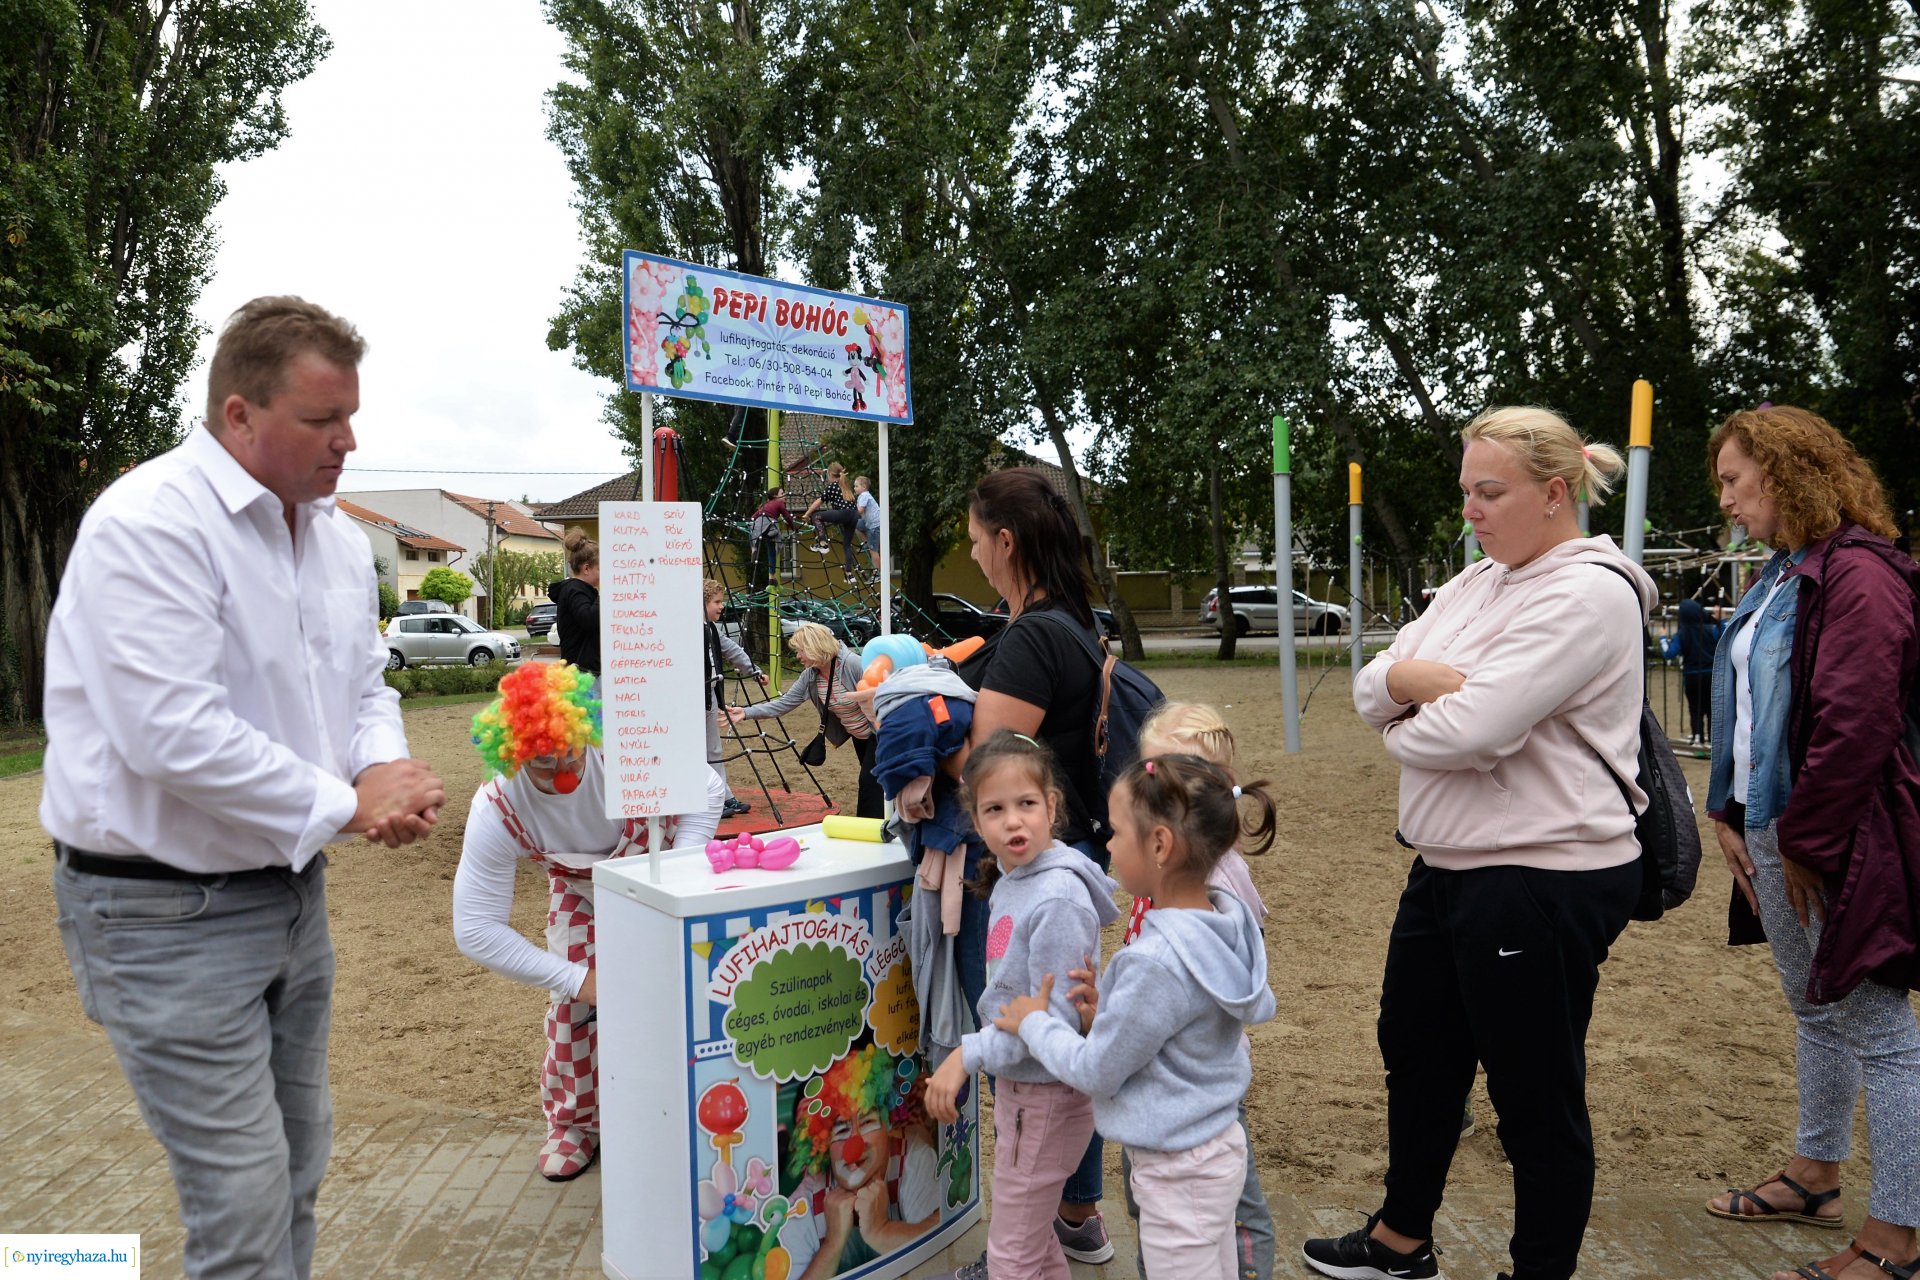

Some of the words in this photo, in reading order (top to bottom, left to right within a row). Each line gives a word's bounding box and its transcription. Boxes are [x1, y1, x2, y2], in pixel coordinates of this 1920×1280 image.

[712, 286, 768, 324] PEPI
[775, 298, 850, 338] BOHÓC
[720, 331, 789, 355] lufihajtogatás,
[792, 344, 836, 360] dekoráció
[725, 353, 746, 367] Tel.:
[748, 357, 833, 379] 06/30-508-54-04
[705, 371, 754, 388] Facebook:
[757, 378, 786, 393] Pintér
[788, 384, 802, 395] Pál
[804, 385, 823, 400] Pepi
[825, 388, 852, 402] Bohóc
[614, 511, 641, 521] KARD
[612, 525, 649, 537] KUTYA
[664, 523, 684, 535] PÓK
[612, 543, 637, 552] CICA
[612, 558, 646, 569] CSIGA
[613, 572, 656, 585] HATTYÚ
[612, 589, 648, 602] ZSIRÁF
[612, 609, 658, 619] LOVACSKA
[613, 639, 665, 651] PILLANGÓ
[610, 656, 674, 669] GÉPFEGYVER
[614, 676, 648, 685] KATICA
[615, 692, 641, 703] MACI
[615, 710, 646, 719] TIGRIS
[618, 721, 669, 736] OROSZLÁN
[620, 739, 652, 751] NYÚL
[620, 769, 650, 783] VIRÁG
[622, 786, 668, 800] PAPAGÁJ
[712, 918, 870, 998] LUFIHAJTOGATÁS
[769, 968, 833, 996] Szülinapok
[728, 1011, 769, 1032] céges,
[773, 999, 815, 1022] óvodai,
[818, 990, 852, 1012] iskolai
[854, 987, 867, 1001] és
[888, 1000, 903, 1015] lufi
[737, 1032, 776, 1058] egyéb
[779, 1012, 860, 1046] rendezvények.
